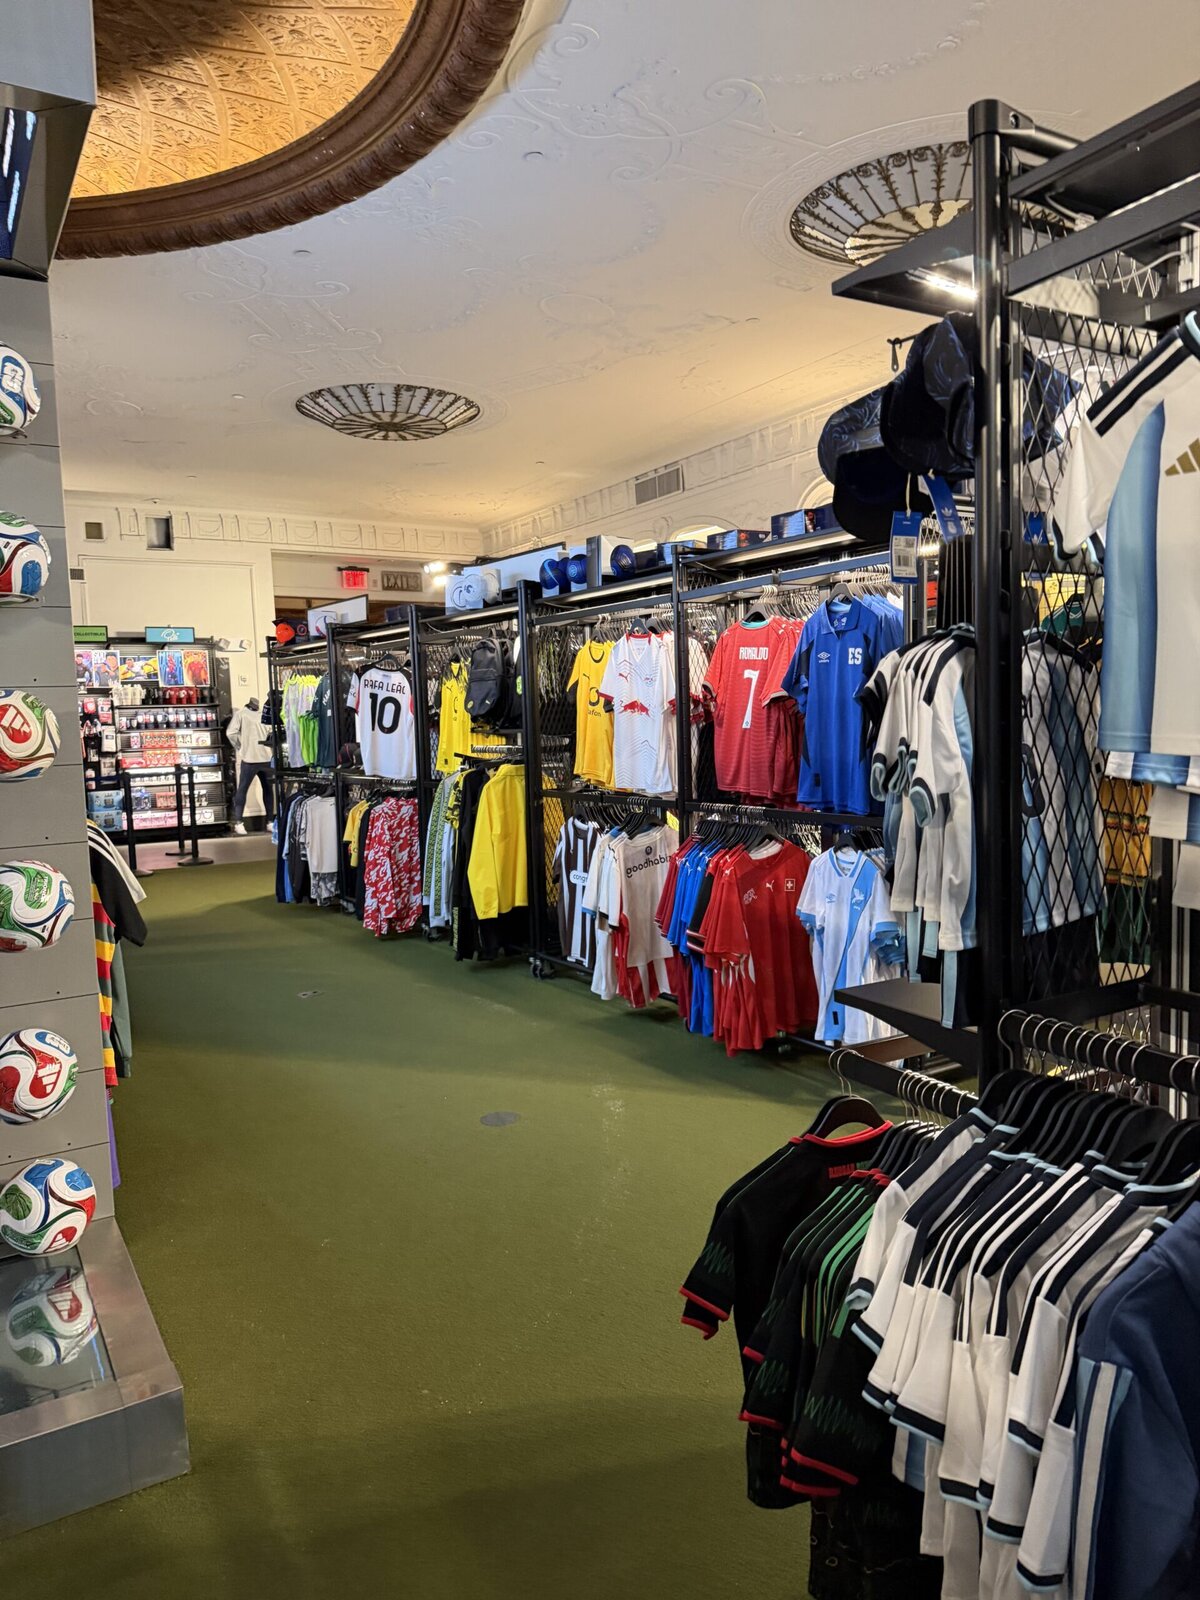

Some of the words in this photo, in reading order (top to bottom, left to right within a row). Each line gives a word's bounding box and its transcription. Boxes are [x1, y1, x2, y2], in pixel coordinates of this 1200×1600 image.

[739, 647, 769, 660] RONALDO
[848, 647, 863, 665] ES
[369, 692, 402, 735] 10
[742, 669, 760, 729] 7
